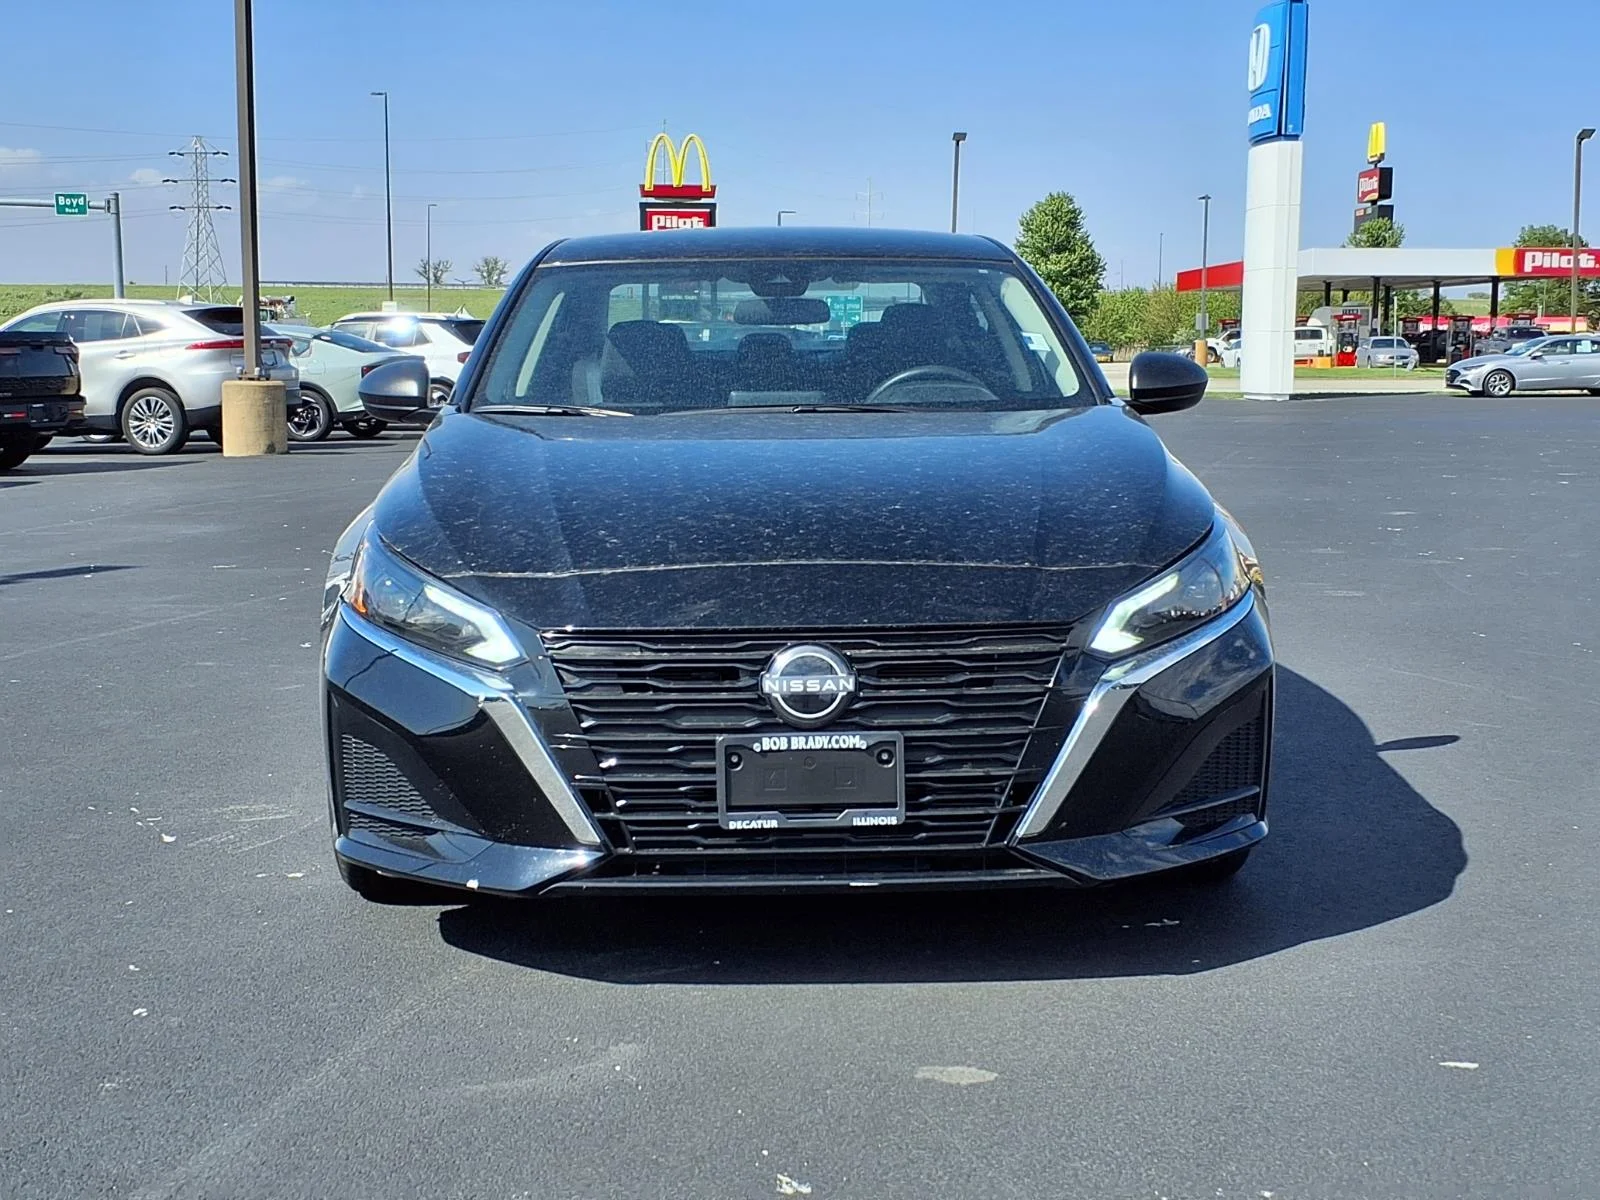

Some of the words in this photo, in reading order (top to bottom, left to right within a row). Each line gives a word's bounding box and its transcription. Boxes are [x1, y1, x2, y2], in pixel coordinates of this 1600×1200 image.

[1359, 176, 1379, 198] Pilot
[58, 196, 84, 207] Boyd
[651, 215, 704, 231] Pilot
[765, 679, 854, 693] NISSAN
[761, 736, 788, 751] BOB
[790, 735, 861, 750] BRADY.COM
[728, 820, 778, 830] DECATUR
[852, 816, 898, 826] ILLINOIS
